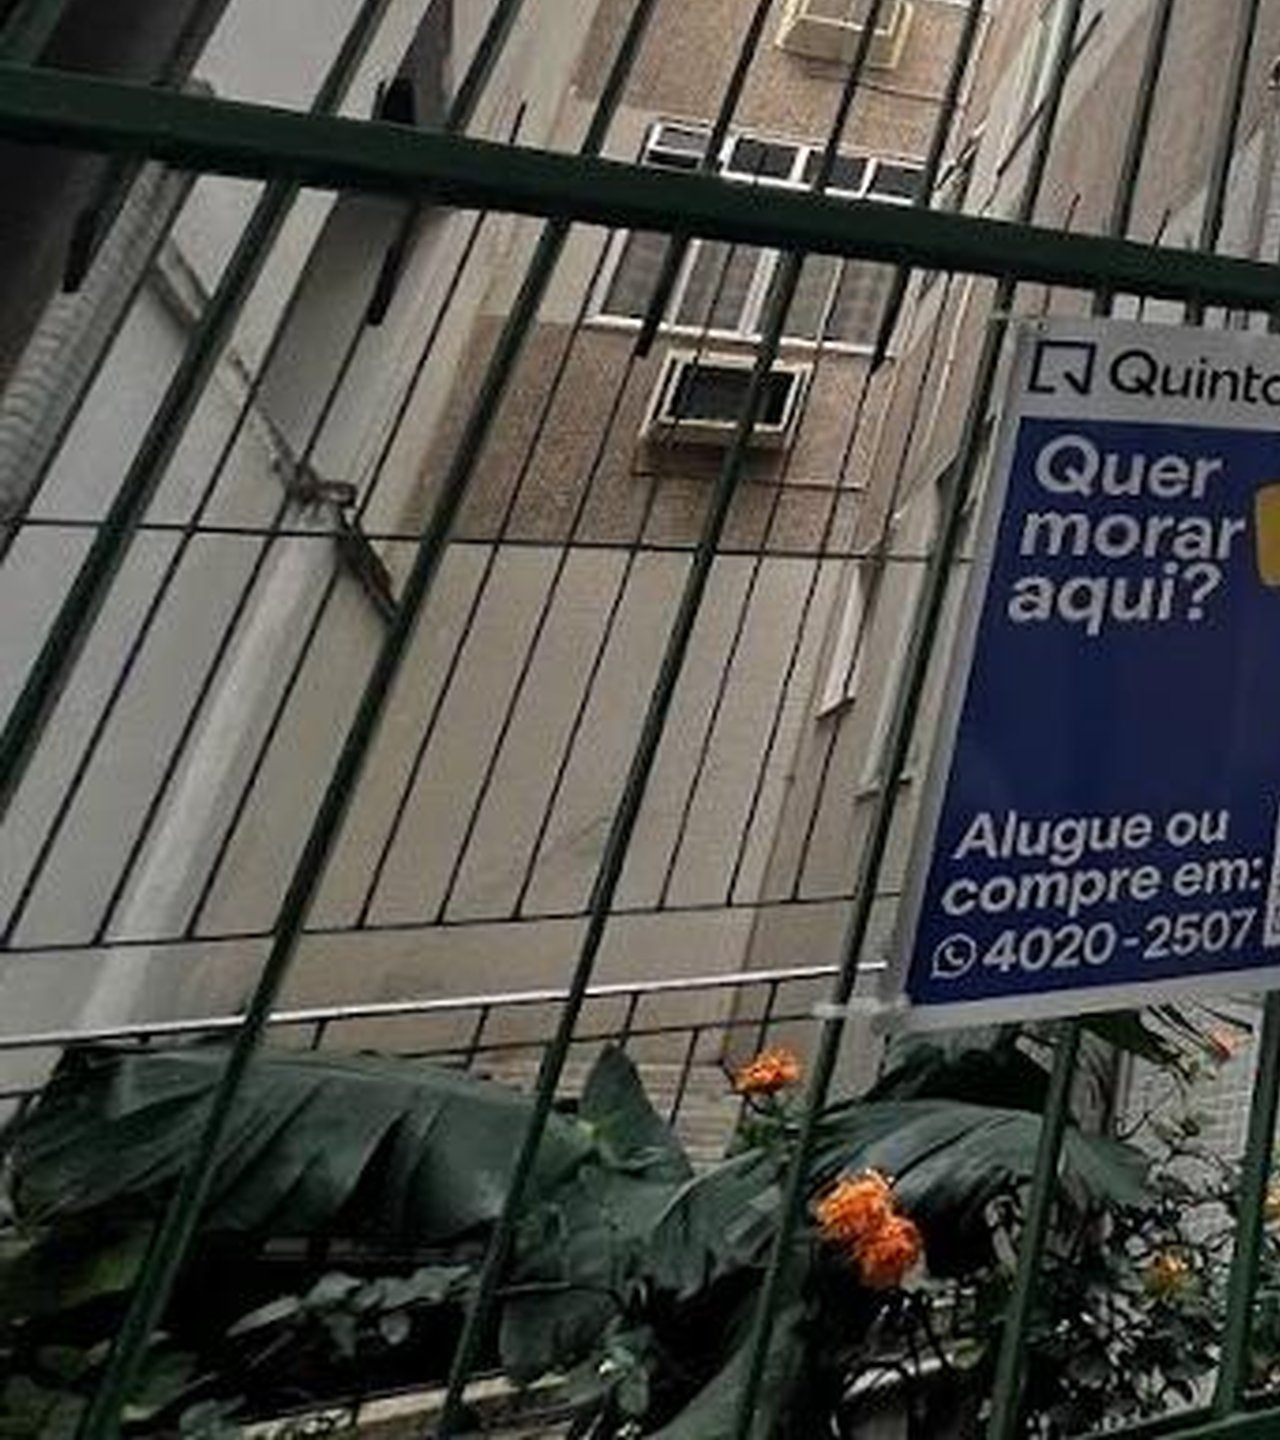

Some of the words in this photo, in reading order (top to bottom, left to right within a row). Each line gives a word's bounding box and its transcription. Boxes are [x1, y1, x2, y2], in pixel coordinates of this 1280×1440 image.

[1034, 433, 1223, 499] Quer
[1019, 510, 1247, 560] morar
[1007, 561, 1222, 637] aqui?
[952, 809, 1152, 867] Alugue
[1165, 808, 1230, 846] ou
[941, 864, 1161, 918] compre
[1172, 856, 1264, 897] em:
[981, 907, 1258, 972] 4020-2507
